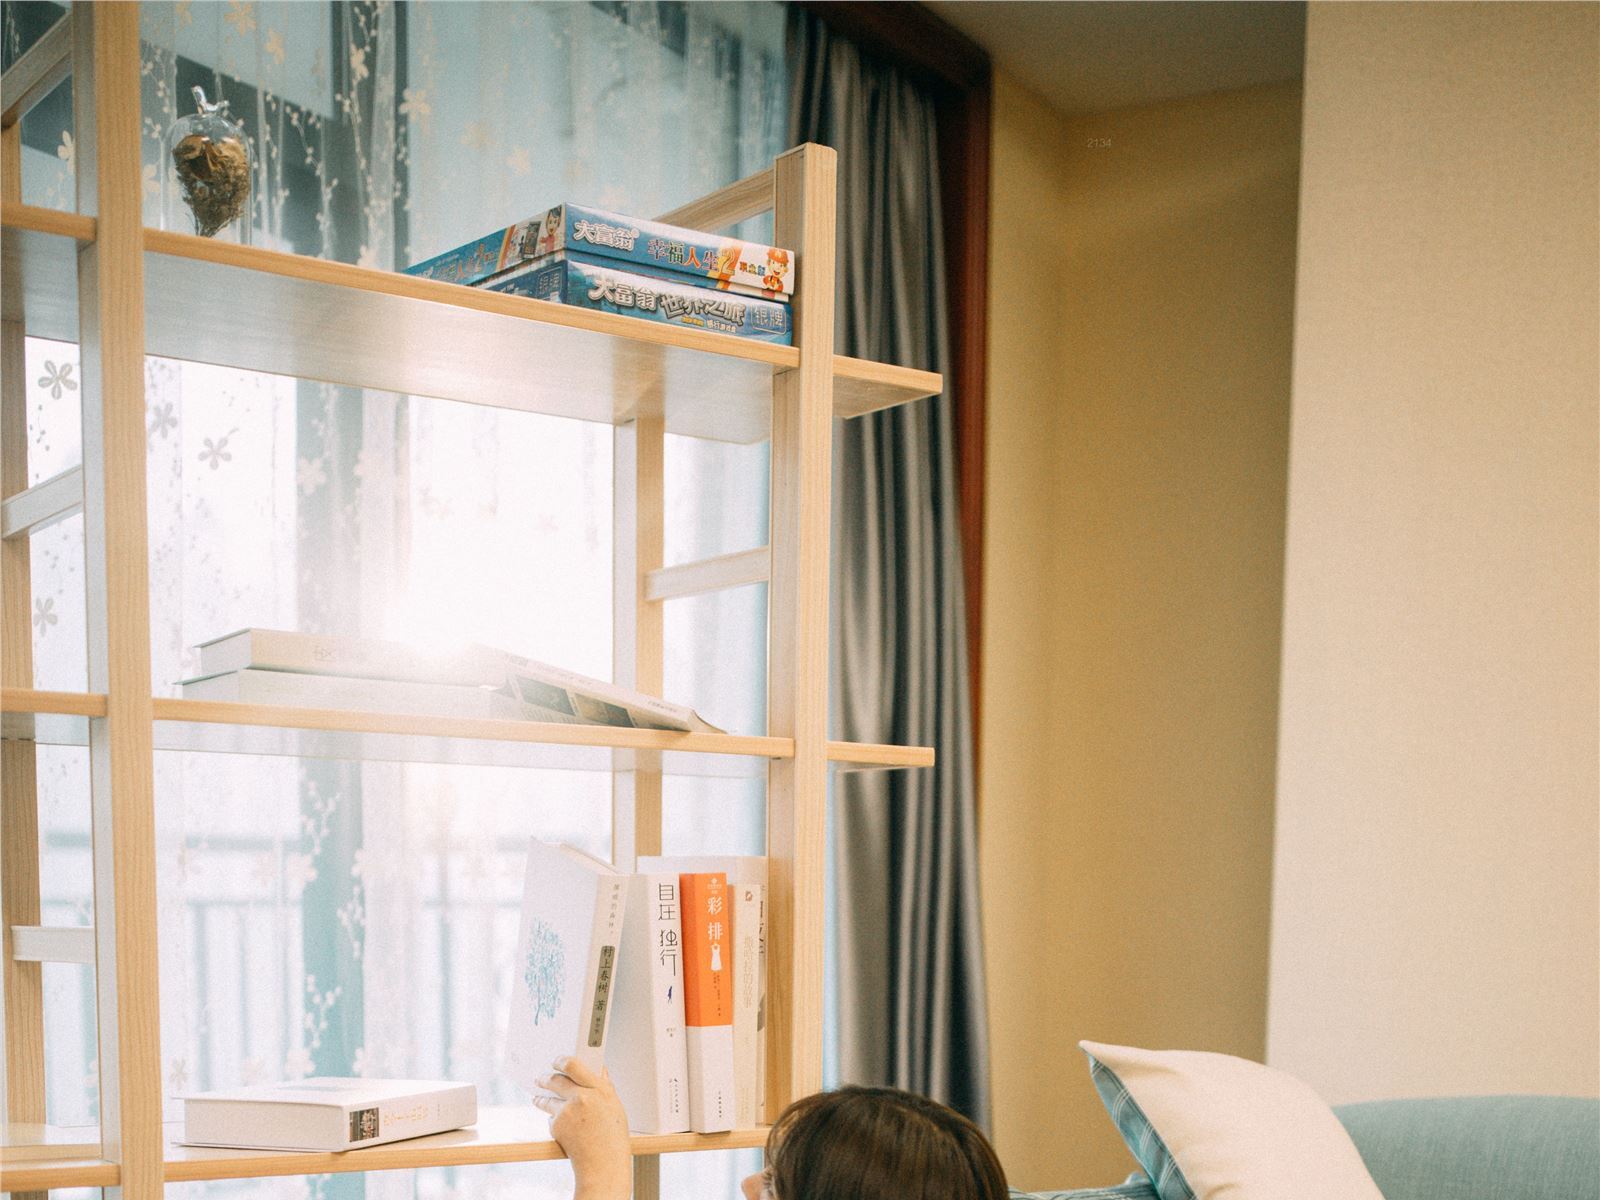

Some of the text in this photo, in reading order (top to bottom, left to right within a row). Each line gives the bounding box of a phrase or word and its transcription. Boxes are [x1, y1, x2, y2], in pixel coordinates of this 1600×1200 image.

[573, 219, 634, 251] 大富翁
[588, 278, 658, 312] 大富翁
[660, 294, 746, 326] 世界之旅
[658, 883, 678, 976] 自在独行
[708, 896, 723, 940] 彩排
[598, 946, 615, 992] 村上春树
